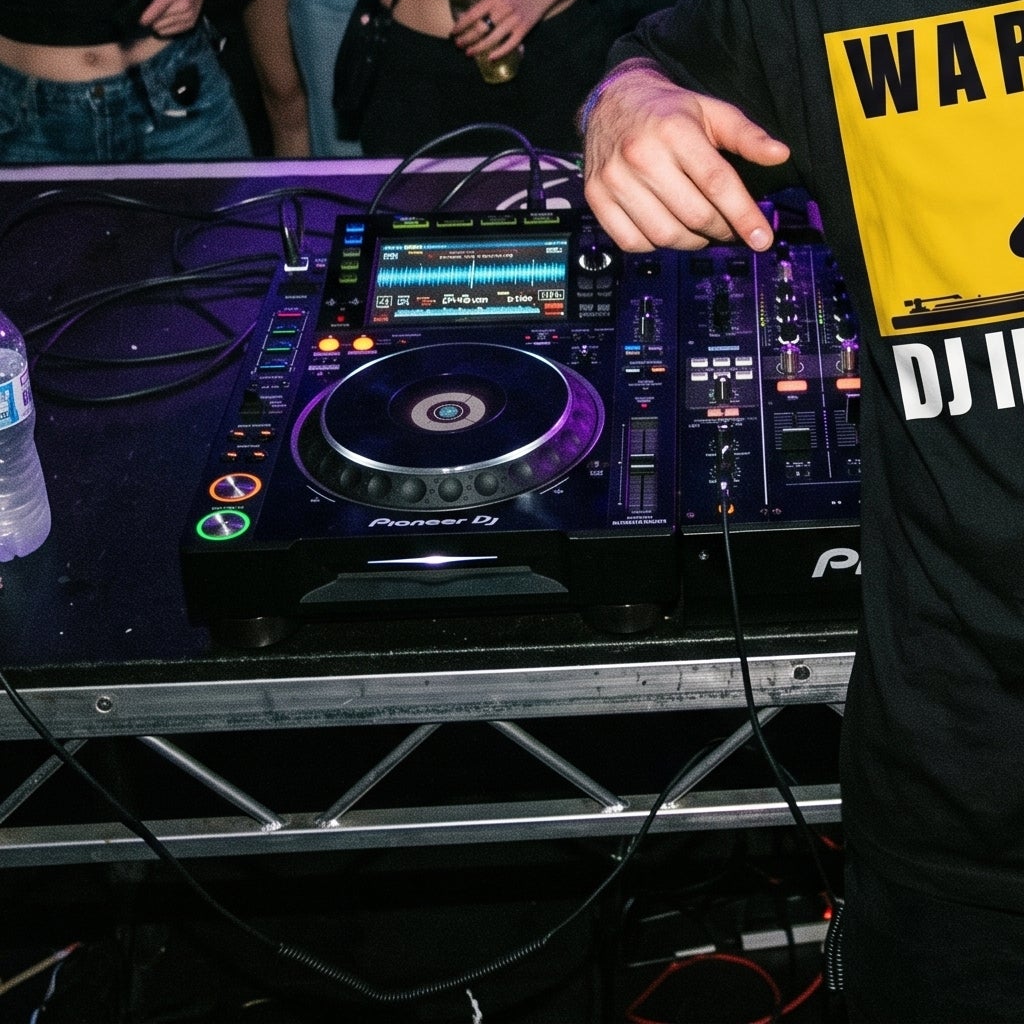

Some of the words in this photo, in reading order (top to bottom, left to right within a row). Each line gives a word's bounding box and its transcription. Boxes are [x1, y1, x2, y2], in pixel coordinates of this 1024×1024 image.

[892, 332, 974, 421] DJ
[368, 517, 467, 527] Pioneer
[471, 515, 500, 526] DJ
